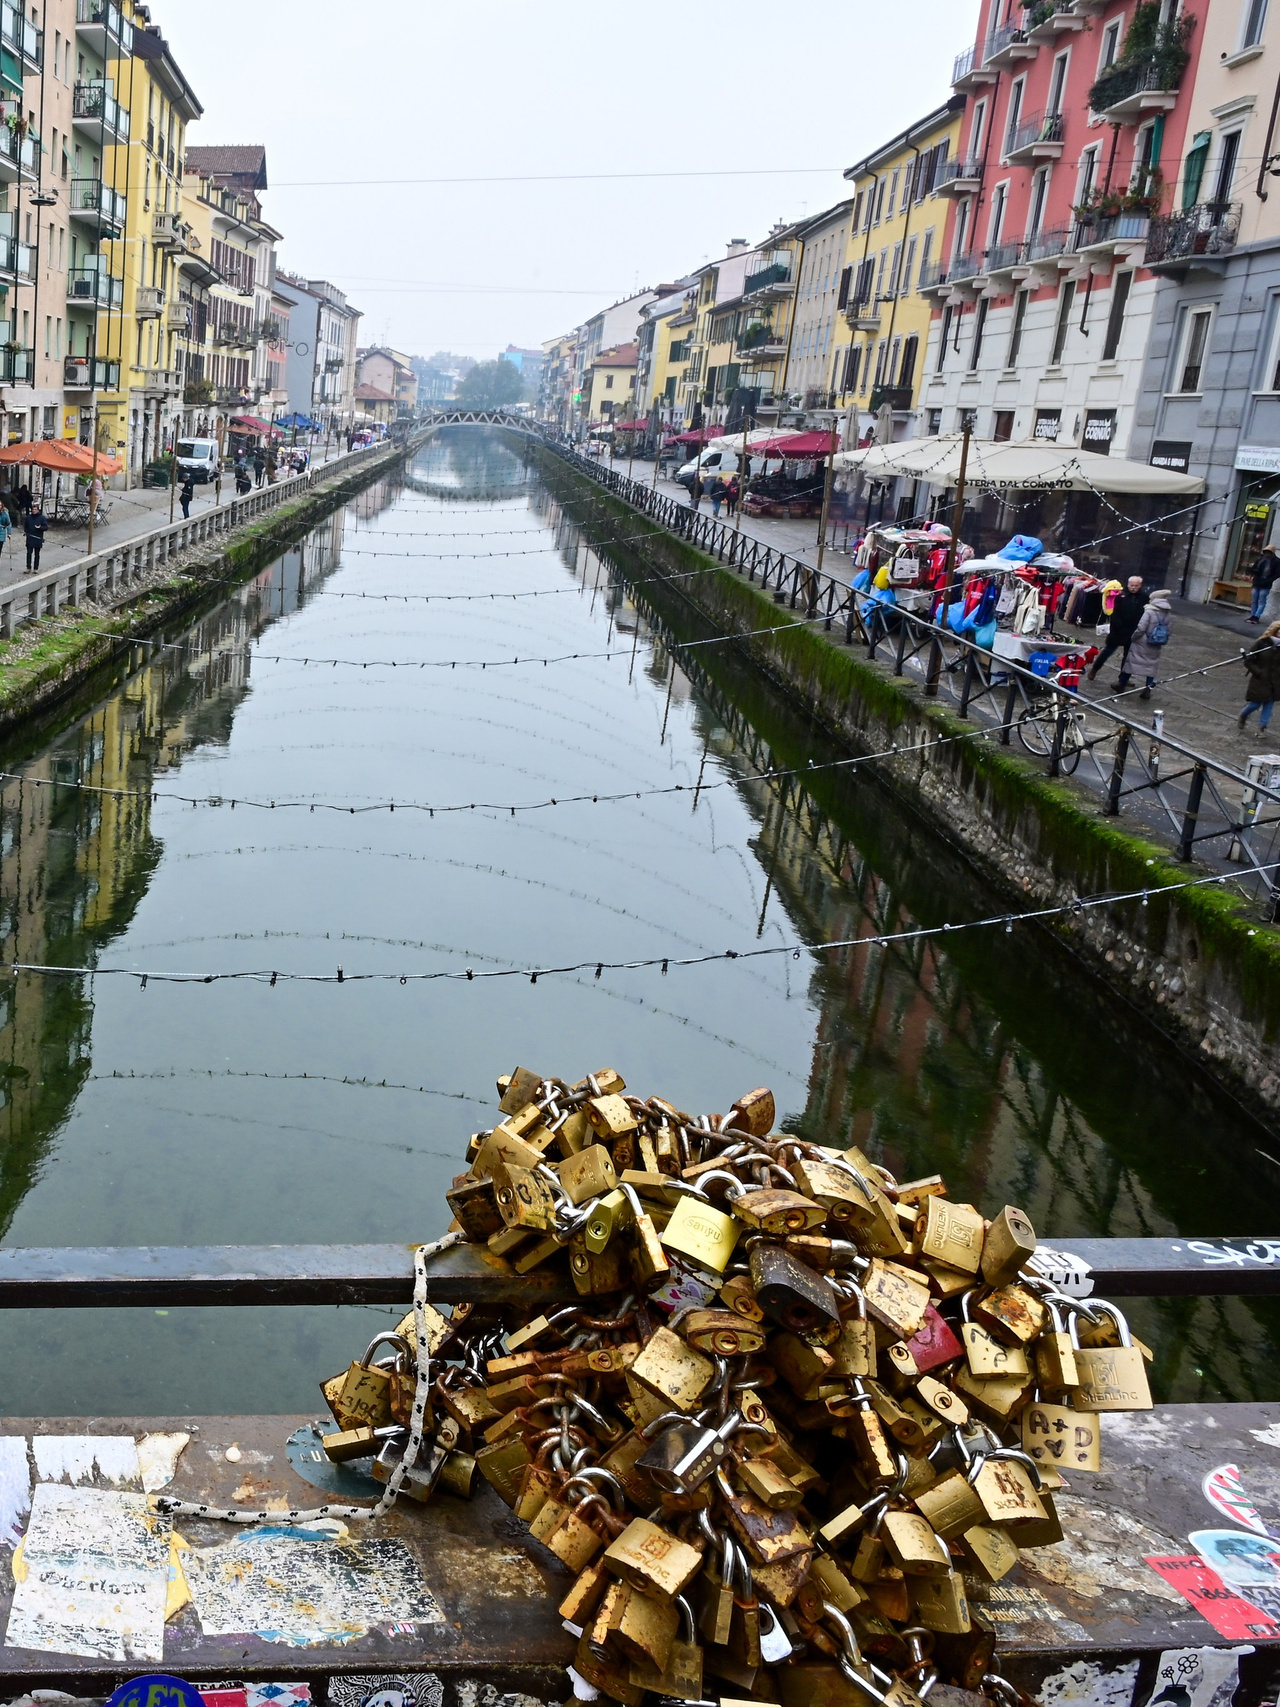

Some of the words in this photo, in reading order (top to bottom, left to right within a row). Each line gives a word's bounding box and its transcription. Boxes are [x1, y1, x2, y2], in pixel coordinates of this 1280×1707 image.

[1085, 426, 1111, 440] CORNUTO
[954, 478, 997, 488] OSTERIA
[1022, 480, 1073, 488] CORNUTO
[937, 555, 944, 566] 7
[687, 1219, 721, 1240] sanyu
[933, 1204, 947, 1249] SHENLING
[1082, 1391, 1138, 1404] SHENLING
[1156, 1560, 1205, 1570] NFFC
[1188, 1588, 1241, 1600] 1865
